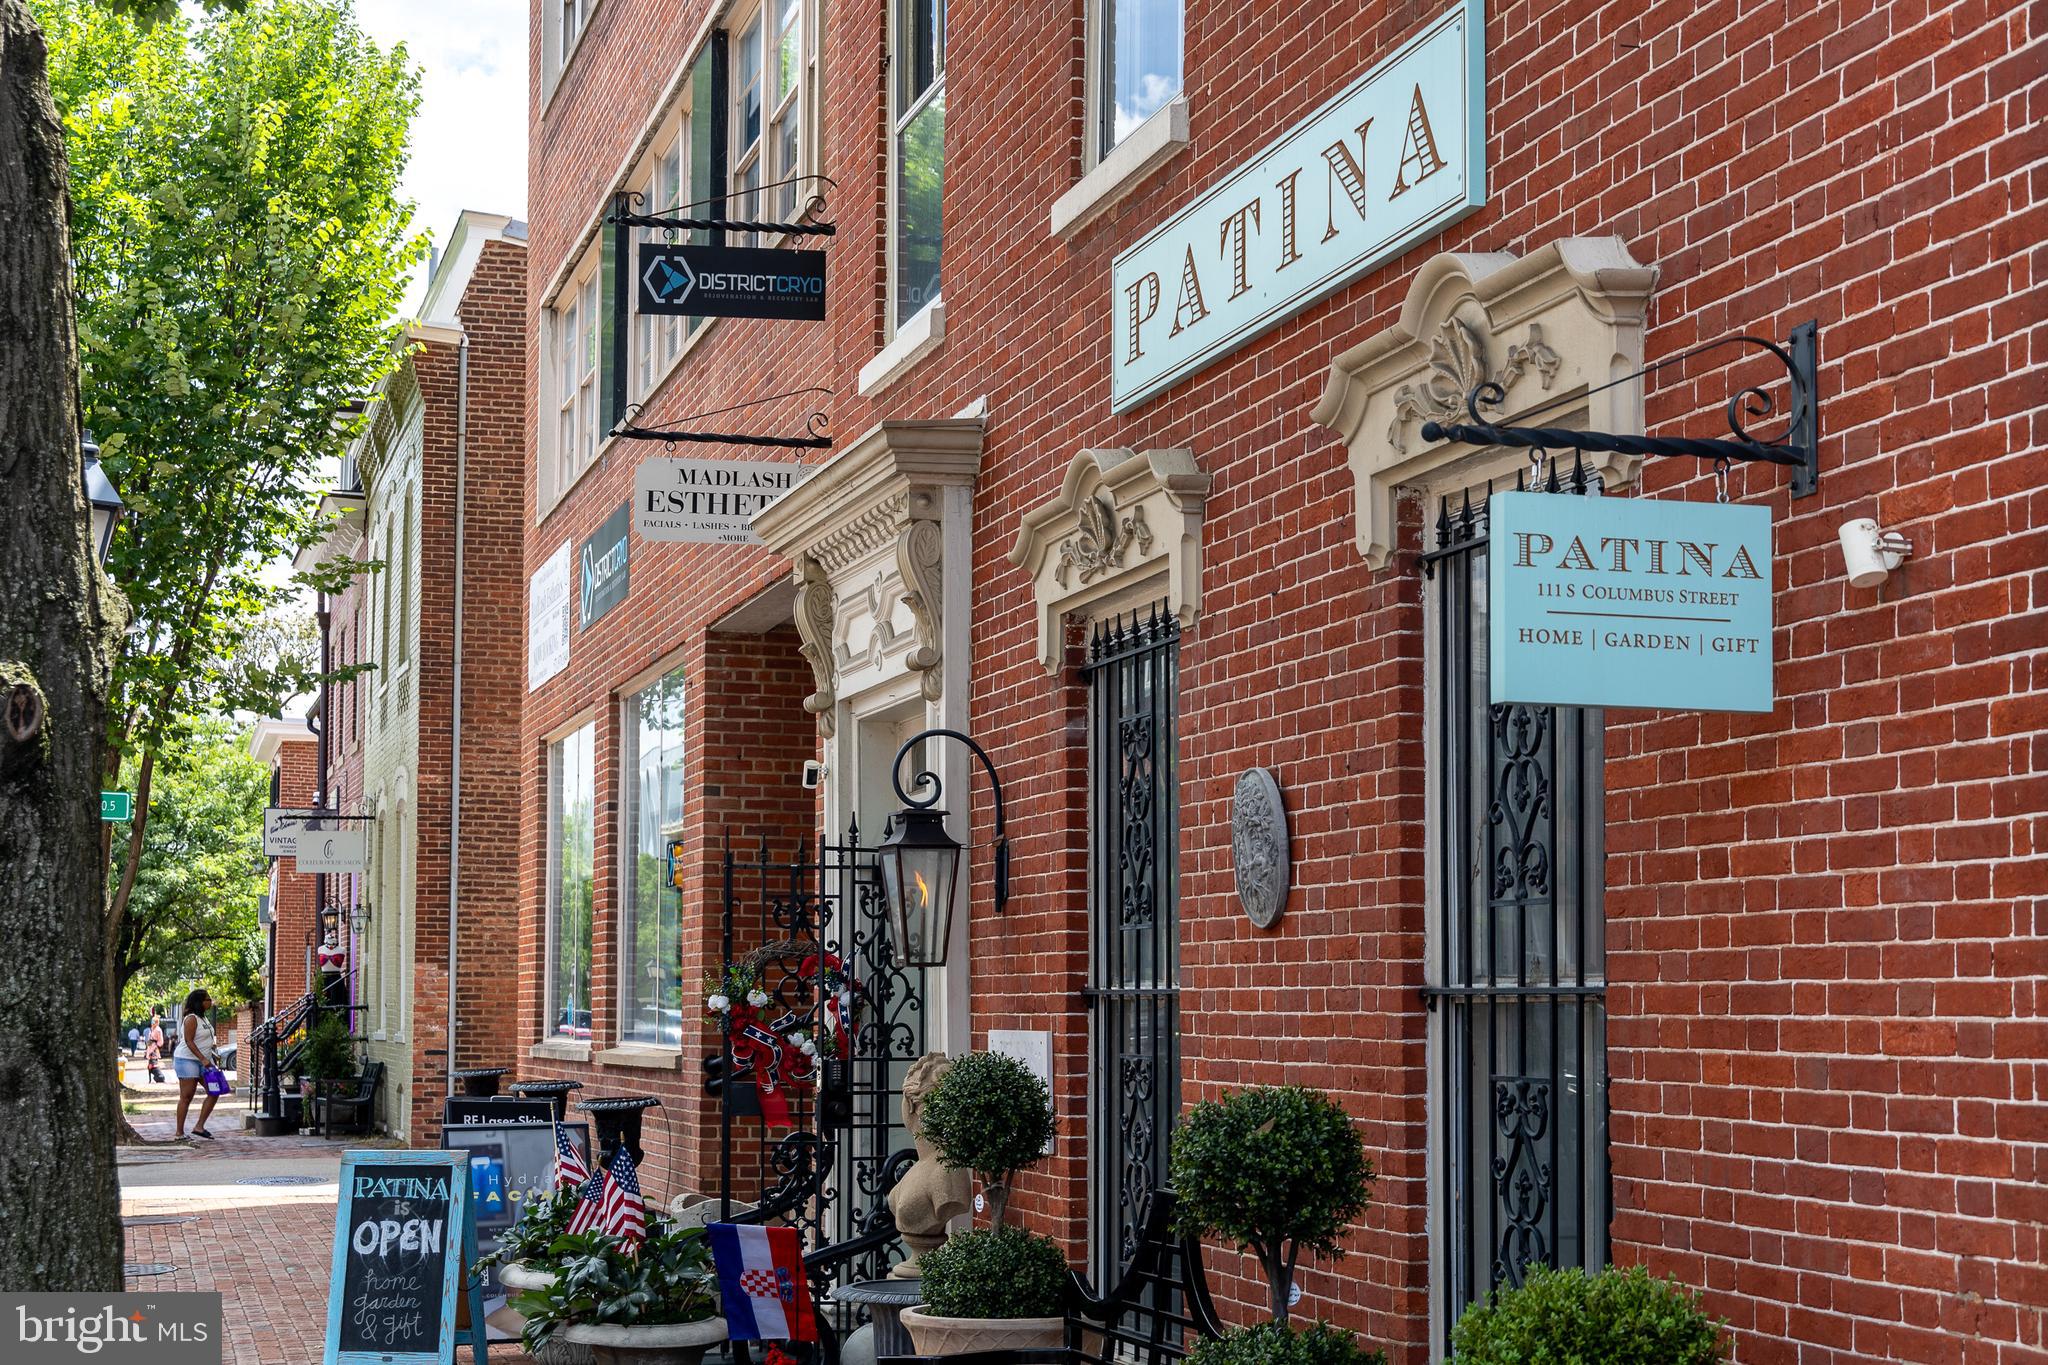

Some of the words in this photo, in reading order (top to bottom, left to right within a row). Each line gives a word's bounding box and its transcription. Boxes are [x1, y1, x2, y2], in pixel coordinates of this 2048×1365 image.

[1124, 82, 1448, 366] PATINA
[699, 272, 823, 294] DISTRICTCRYO
[677, 468, 793, 489] MADLASH
[645, 489, 779, 516] ESTHET
[643, 519, 682, 529] FACIALS
[693, 521, 730, 530] LASHES
[718, 534, 749, 542] +MORE
[1513, 532, 1764, 580] PATINA
[1537, 583, 1562, 597] 111
[1566, 583, 1575, 597] S
[1582, 584, 1674, 603] COLUMBUS
[1679, 589, 1740, 606] STREET
[1518, 628, 1583, 646] HOME
[1604, 632, 1691, 651] GARDEN
[1712, 637, 1760, 653] GIFT
[482, 1114, 515, 1124] Laser
[353, 1176, 450, 1201] PATINA
[393, 1199, 410, 1216] is
[352, 1218, 443, 1257] OPEN
[365, 1268, 422, 1292] home
[353, 1293, 422, 1325] garden
[361, 1313, 377, 1342] &
[383, 1311, 424, 1345] gift
